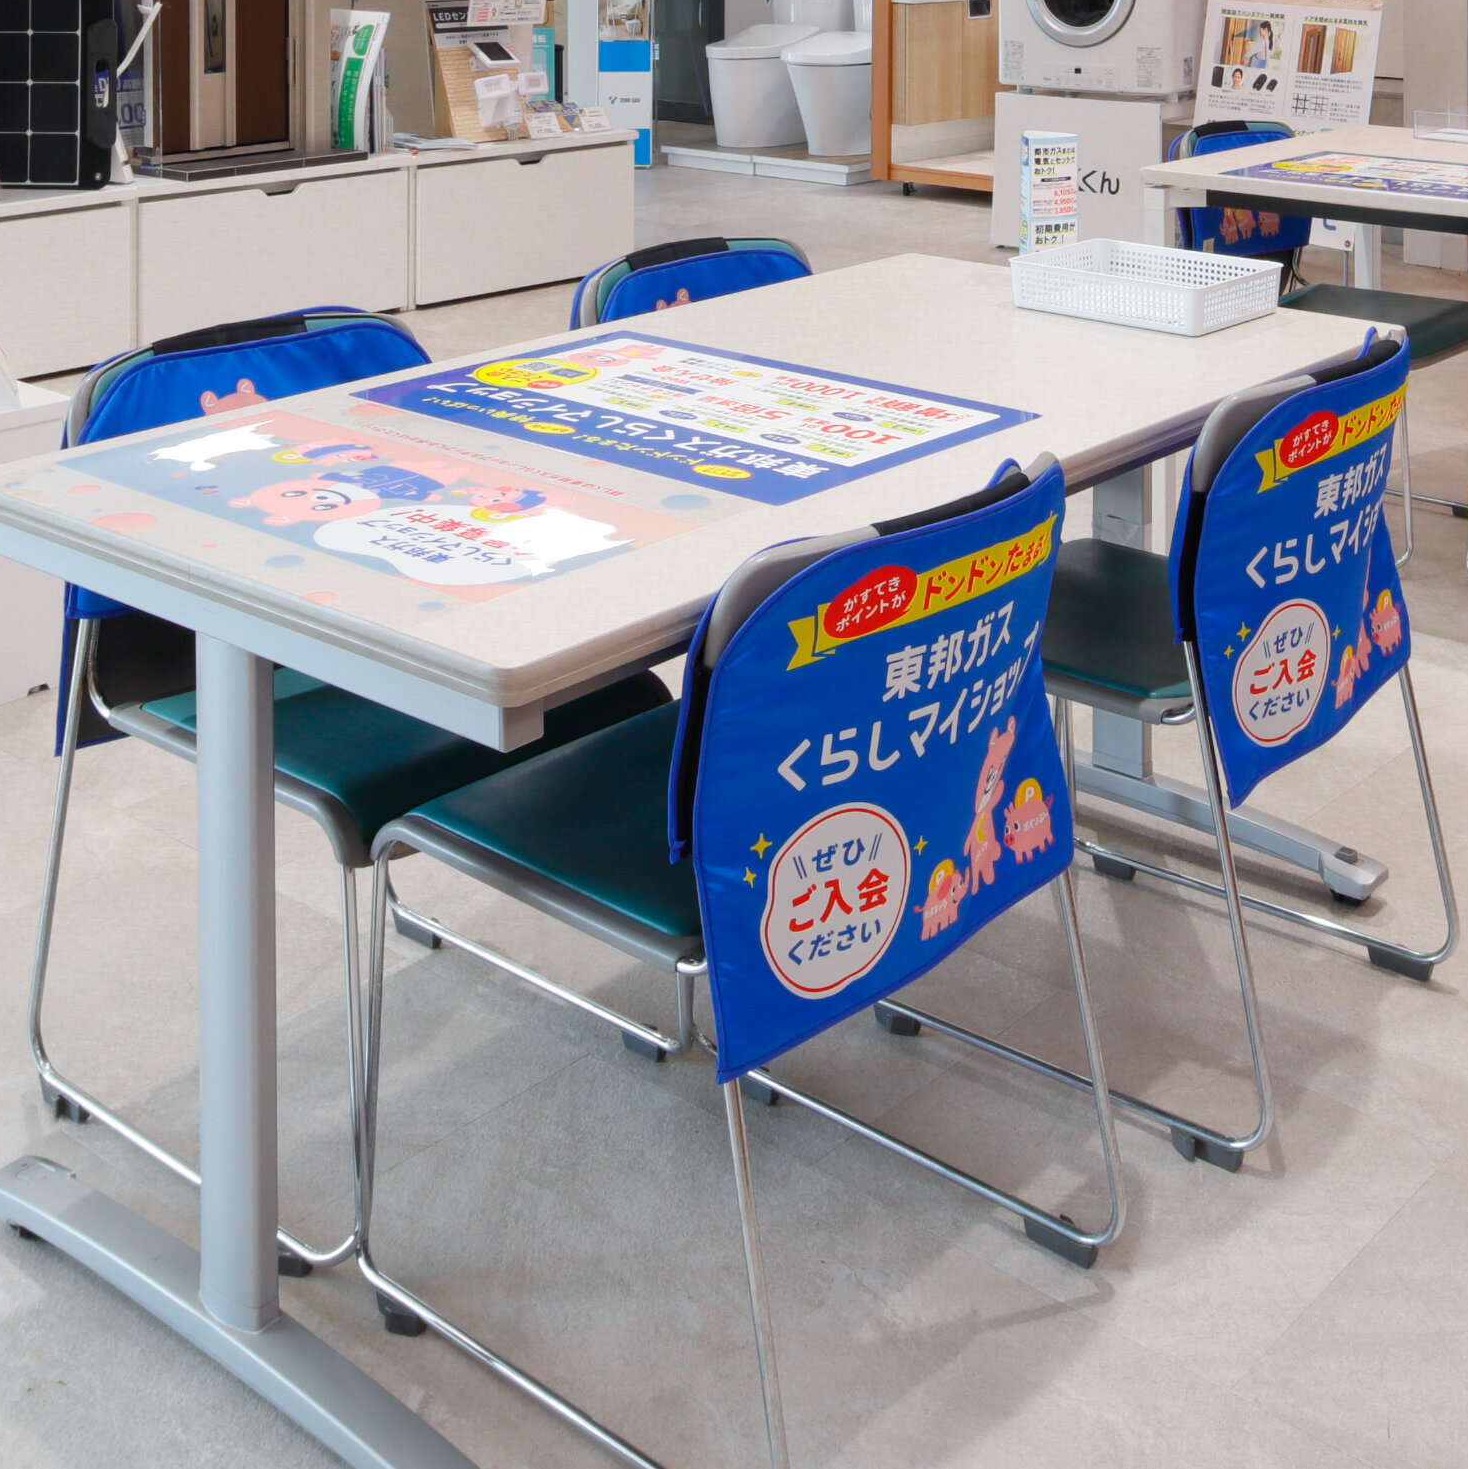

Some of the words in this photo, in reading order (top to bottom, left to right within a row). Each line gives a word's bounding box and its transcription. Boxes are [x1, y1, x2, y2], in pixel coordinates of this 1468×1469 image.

[1034, 146, 1076, 155] 都市ガスまたは
[1034, 156, 1076, 165] 電気とセットで
[1034, 167, 1056, 175] おトク!
[1035, 222, 1076, 234] 初期費用が
[422, 377, 834, 481] 東邦ガスくらしマイショップ
[814, 423, 905, 445] 100
[1293, 418, 1330, 448] がすてき
[1287, 430, 1333, 465] ポイントが
[1313, 443, 1388, 520] 東邦ガス
[355, 515, 517, 568] くらしマイショップ
[369, 533, 449, 567] 東邦ガス
[835, 590, 907, 632] ポイントが
[843, 576, 901, 614] がすてき
[882, 600, 1015, 702] 東邦ガス
[1273, 624, 1304, 656] ぜひ
[1249, 649, 1318, 696] ご入会
[1248, 687, 1311, 722] ください
[811, 837, 866, 874] ぜひ
[788, 868, 890, 932] ご入会
[787, 918, 882, 966] ください
